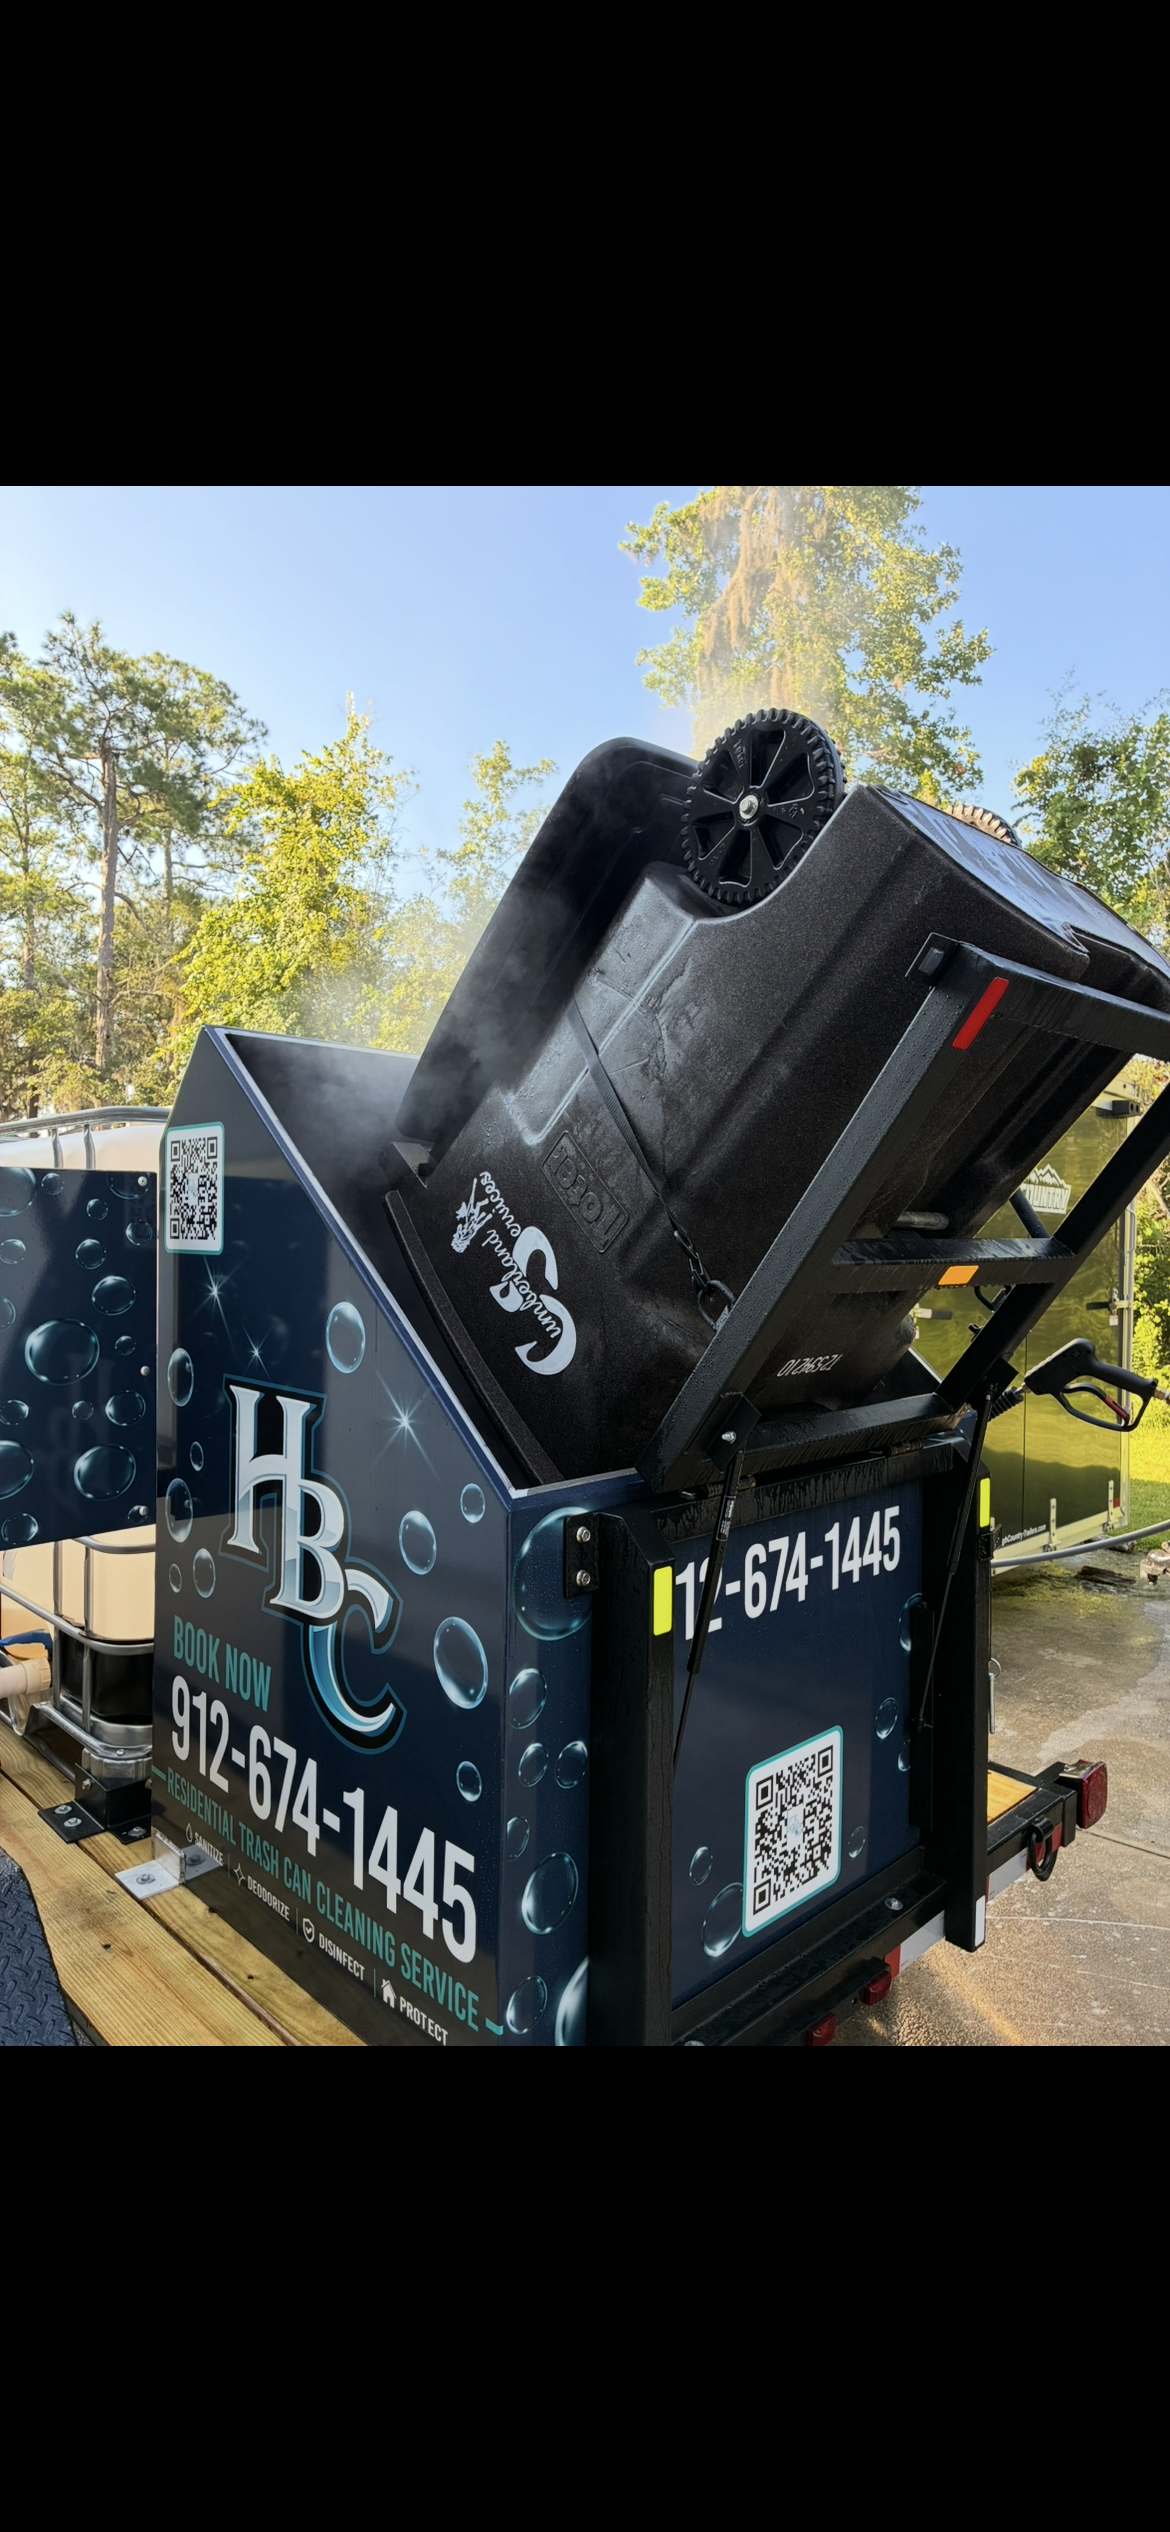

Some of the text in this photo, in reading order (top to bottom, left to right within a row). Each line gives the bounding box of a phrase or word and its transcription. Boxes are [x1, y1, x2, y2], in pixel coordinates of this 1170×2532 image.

[1020, 1184, 1069, 1209] OUNTRY
[226, 1384, 399, 1738] HBC
[173, 1615, 272, 1713] BOOK NOW
[171, 1675, 477, 1963] 912-674-1445
[194, 1833, 224, 1867] SANITIZE
[167, 1767, 479, 2031] RESIDENTIAL TRASH CAN CLEANING SERVICE
[247, 1875, 291, 1922] DEODORIZE
[318, 1932, 366, 1982] DISINFECT
[399, 1996, 449, 2046] PROTECT
